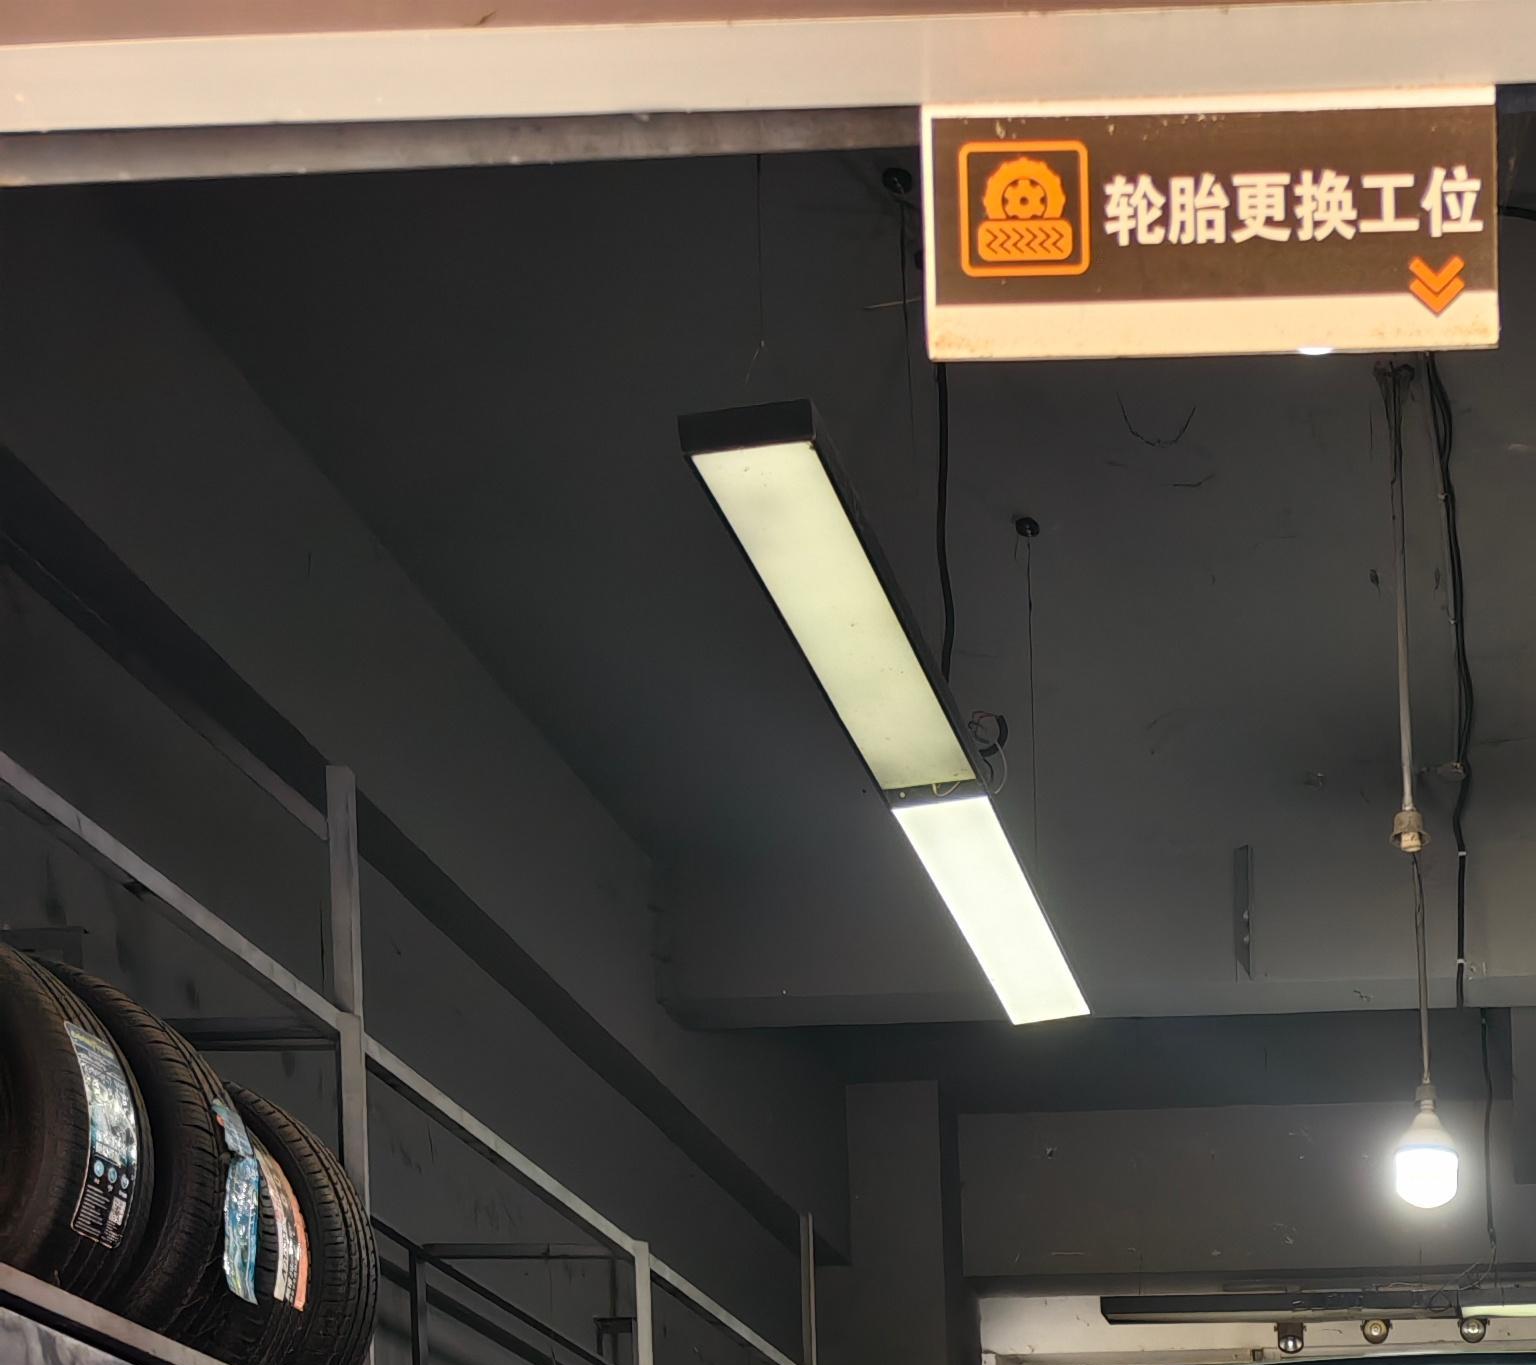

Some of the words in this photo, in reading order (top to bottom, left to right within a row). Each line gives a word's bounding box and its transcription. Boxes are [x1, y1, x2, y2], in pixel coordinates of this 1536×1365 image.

[1103, 165, 1484, 248] 轮胎更换工位
